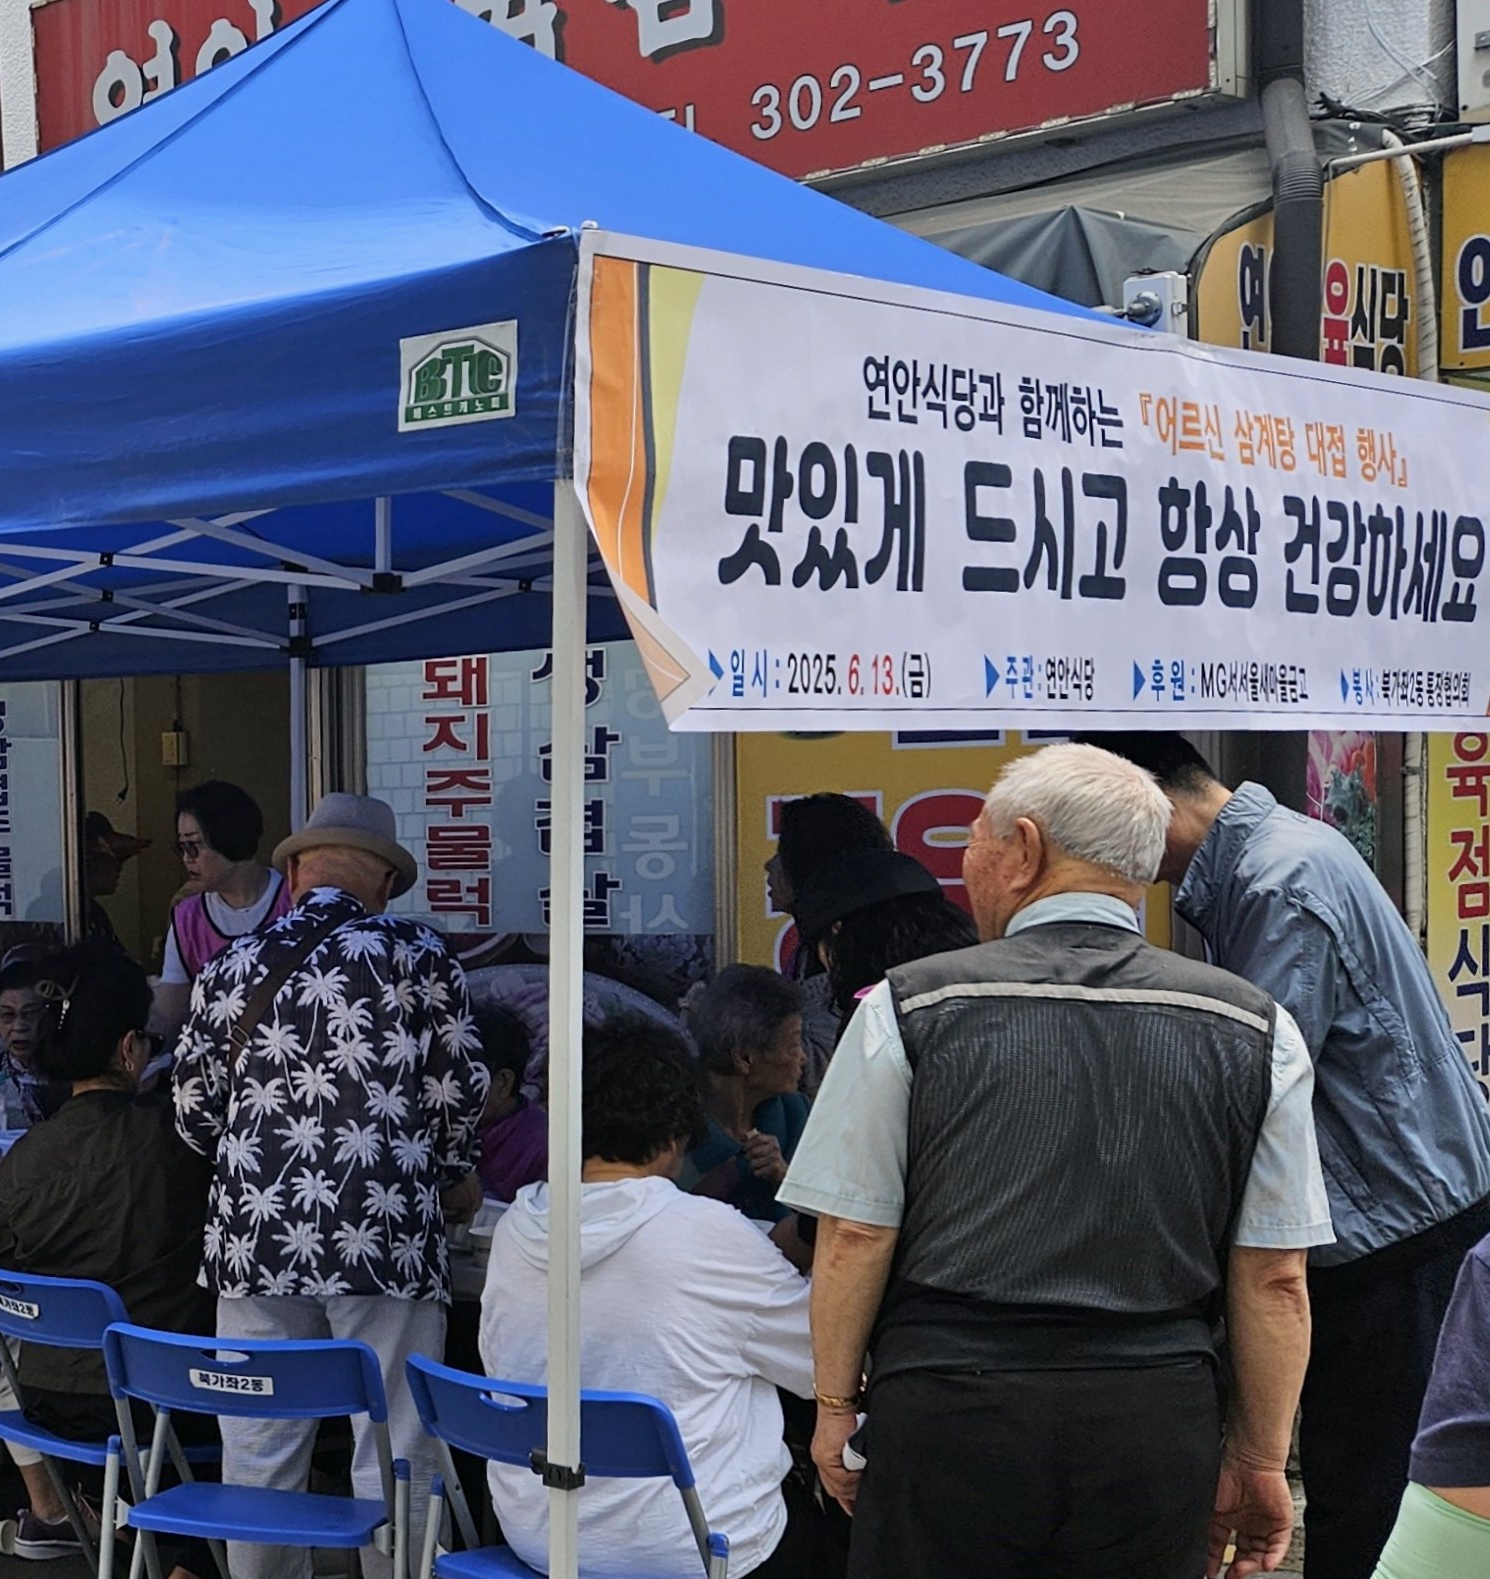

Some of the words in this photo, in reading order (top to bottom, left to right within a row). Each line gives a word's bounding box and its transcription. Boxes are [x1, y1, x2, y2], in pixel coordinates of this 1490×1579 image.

[749, 9, 1082, 140] 302-3773
[863, 355, 1005, 436] 연안식당과
[1018, 376, 1124, 449] 함께하는
[1234, 409, 1297, 472] 삼계탕
[1305, 421, 1347, 479] 대접
[718, 435, 925, 592] 맛있게
[962, 460, 1128, 600] 드시고
[1158, 476, 1260, 609] 항상
[1283, 495, 1486, 623] 건강하세요
[421, 655, 493, 928] 돼지주물럭
[198, 1371, 265, 1393] 북가좌2동
